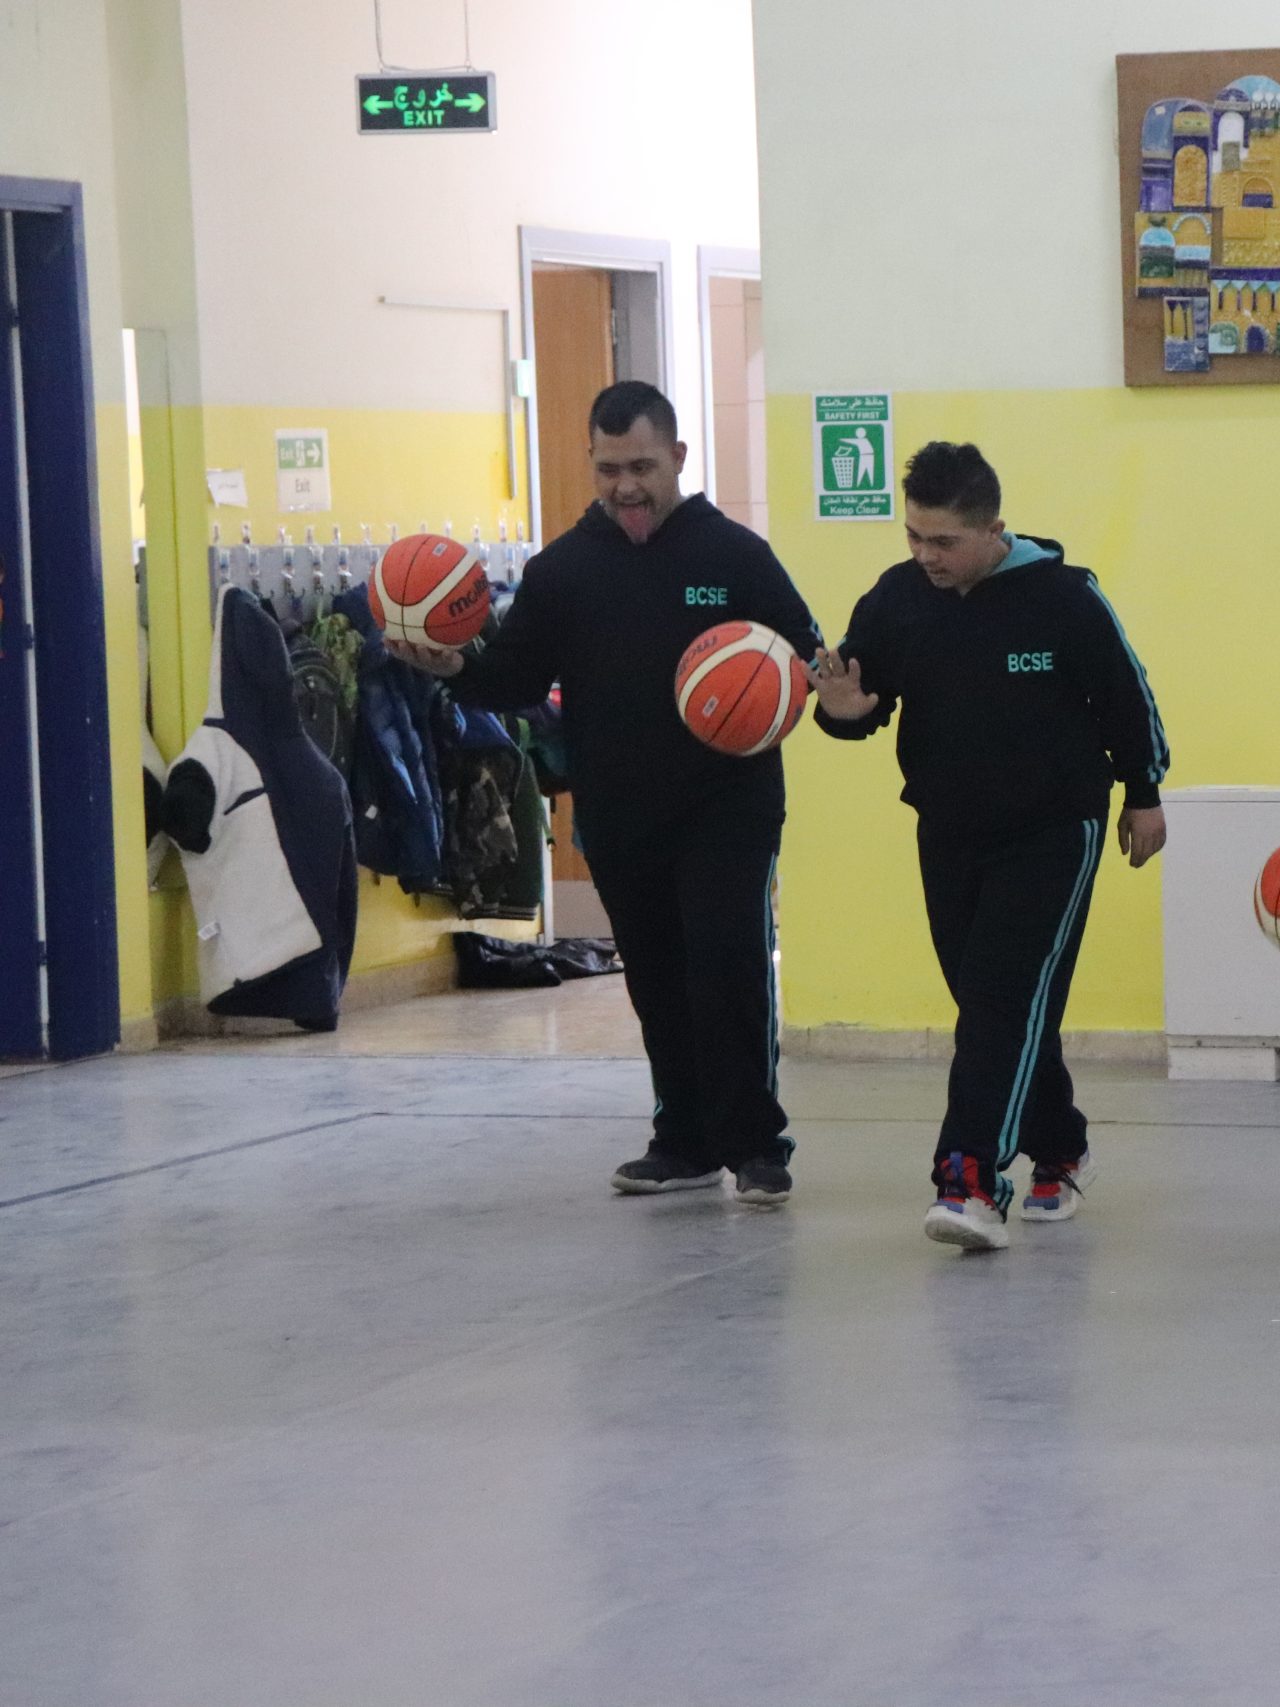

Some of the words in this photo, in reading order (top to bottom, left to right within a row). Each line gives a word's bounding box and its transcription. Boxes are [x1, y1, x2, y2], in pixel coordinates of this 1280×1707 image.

[403, 110, 445, 126] EXIT
[825, 412, 856, 420] SAFETY
[857, 411, 880, 419] FIRST
[295, 477, 311, 493] Exit
[830, 506, 854, 515] Keep
[856, 505, 880, 514] Clear
[685, 586, 728, 605] BCSE
[1008, 652, 1053, 672] BCSE
